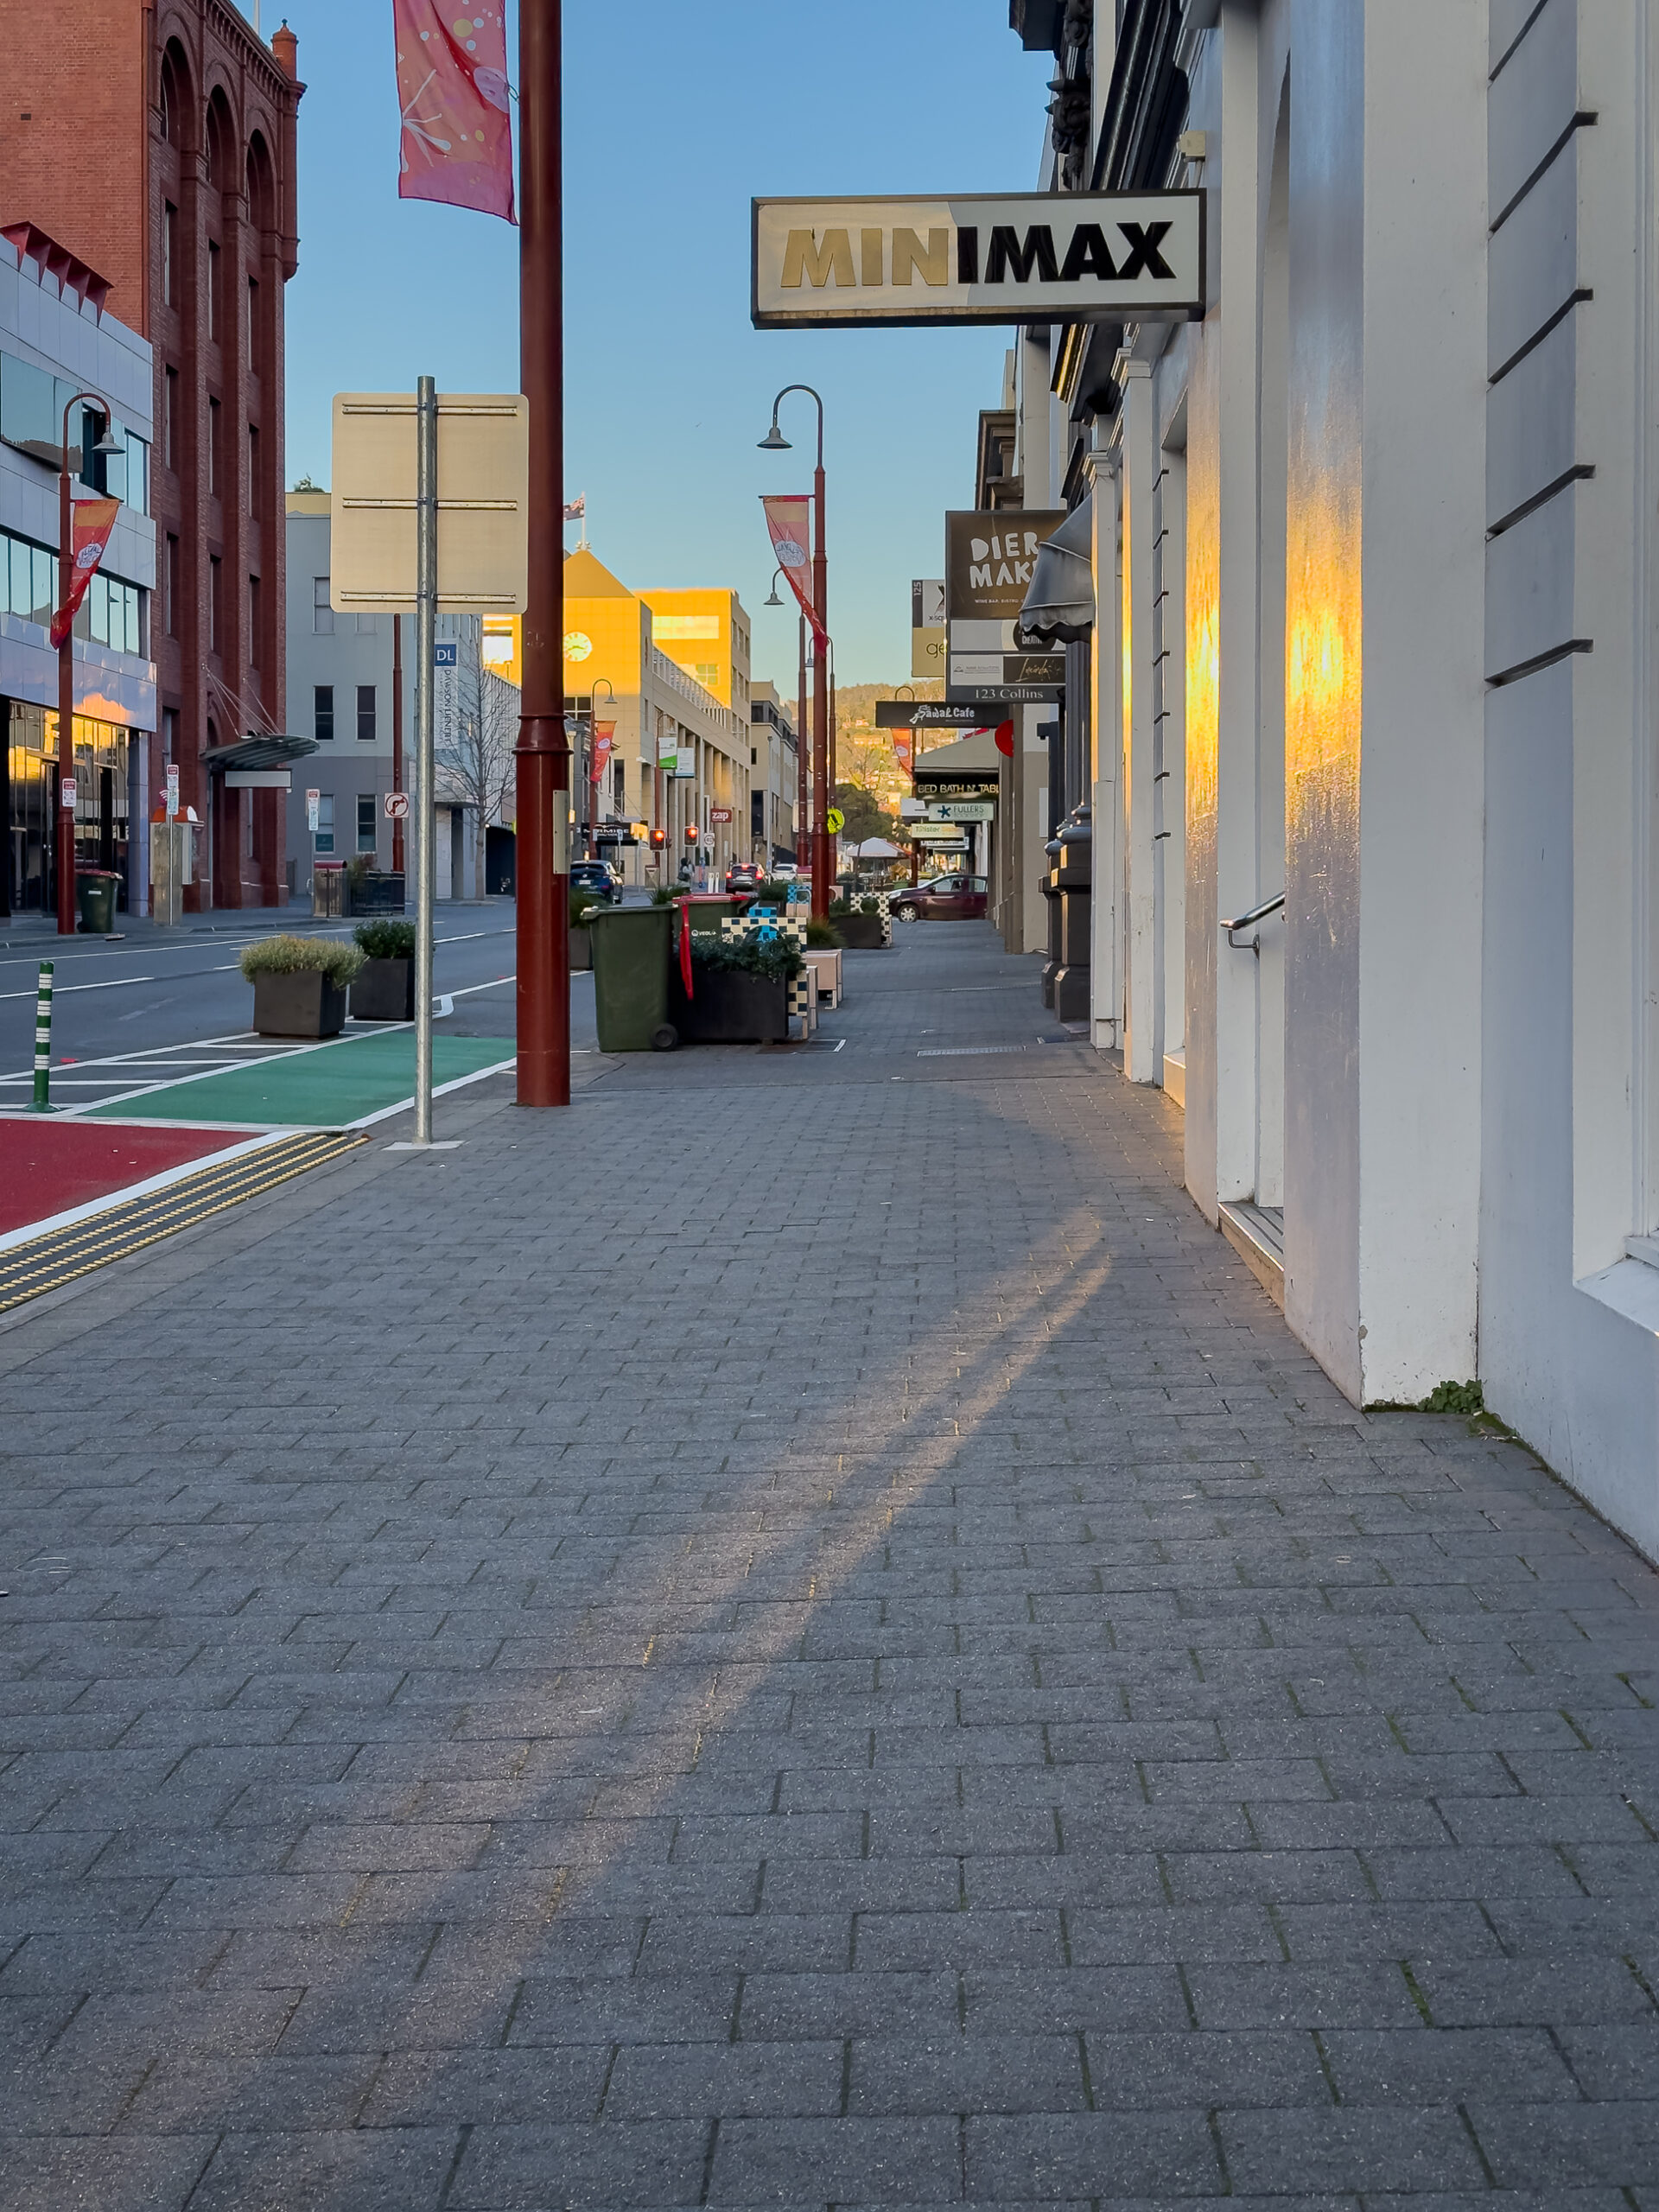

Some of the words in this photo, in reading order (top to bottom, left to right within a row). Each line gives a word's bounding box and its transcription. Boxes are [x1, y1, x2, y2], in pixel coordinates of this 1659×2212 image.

[780, 220, 1177, 288] MINIMAX
[970, 531, 1039, 562] DIER
[436, 649, 454, 661] DL
[975, 689, 995, 699] 123
[1000, 689, 1044, 699] Collins
[953, 707, 975, 718] Cafe
[918, 785, 938, 793] BED
[940, 785, 964, 793] BATH
[712, 812, 729, 821] zap
